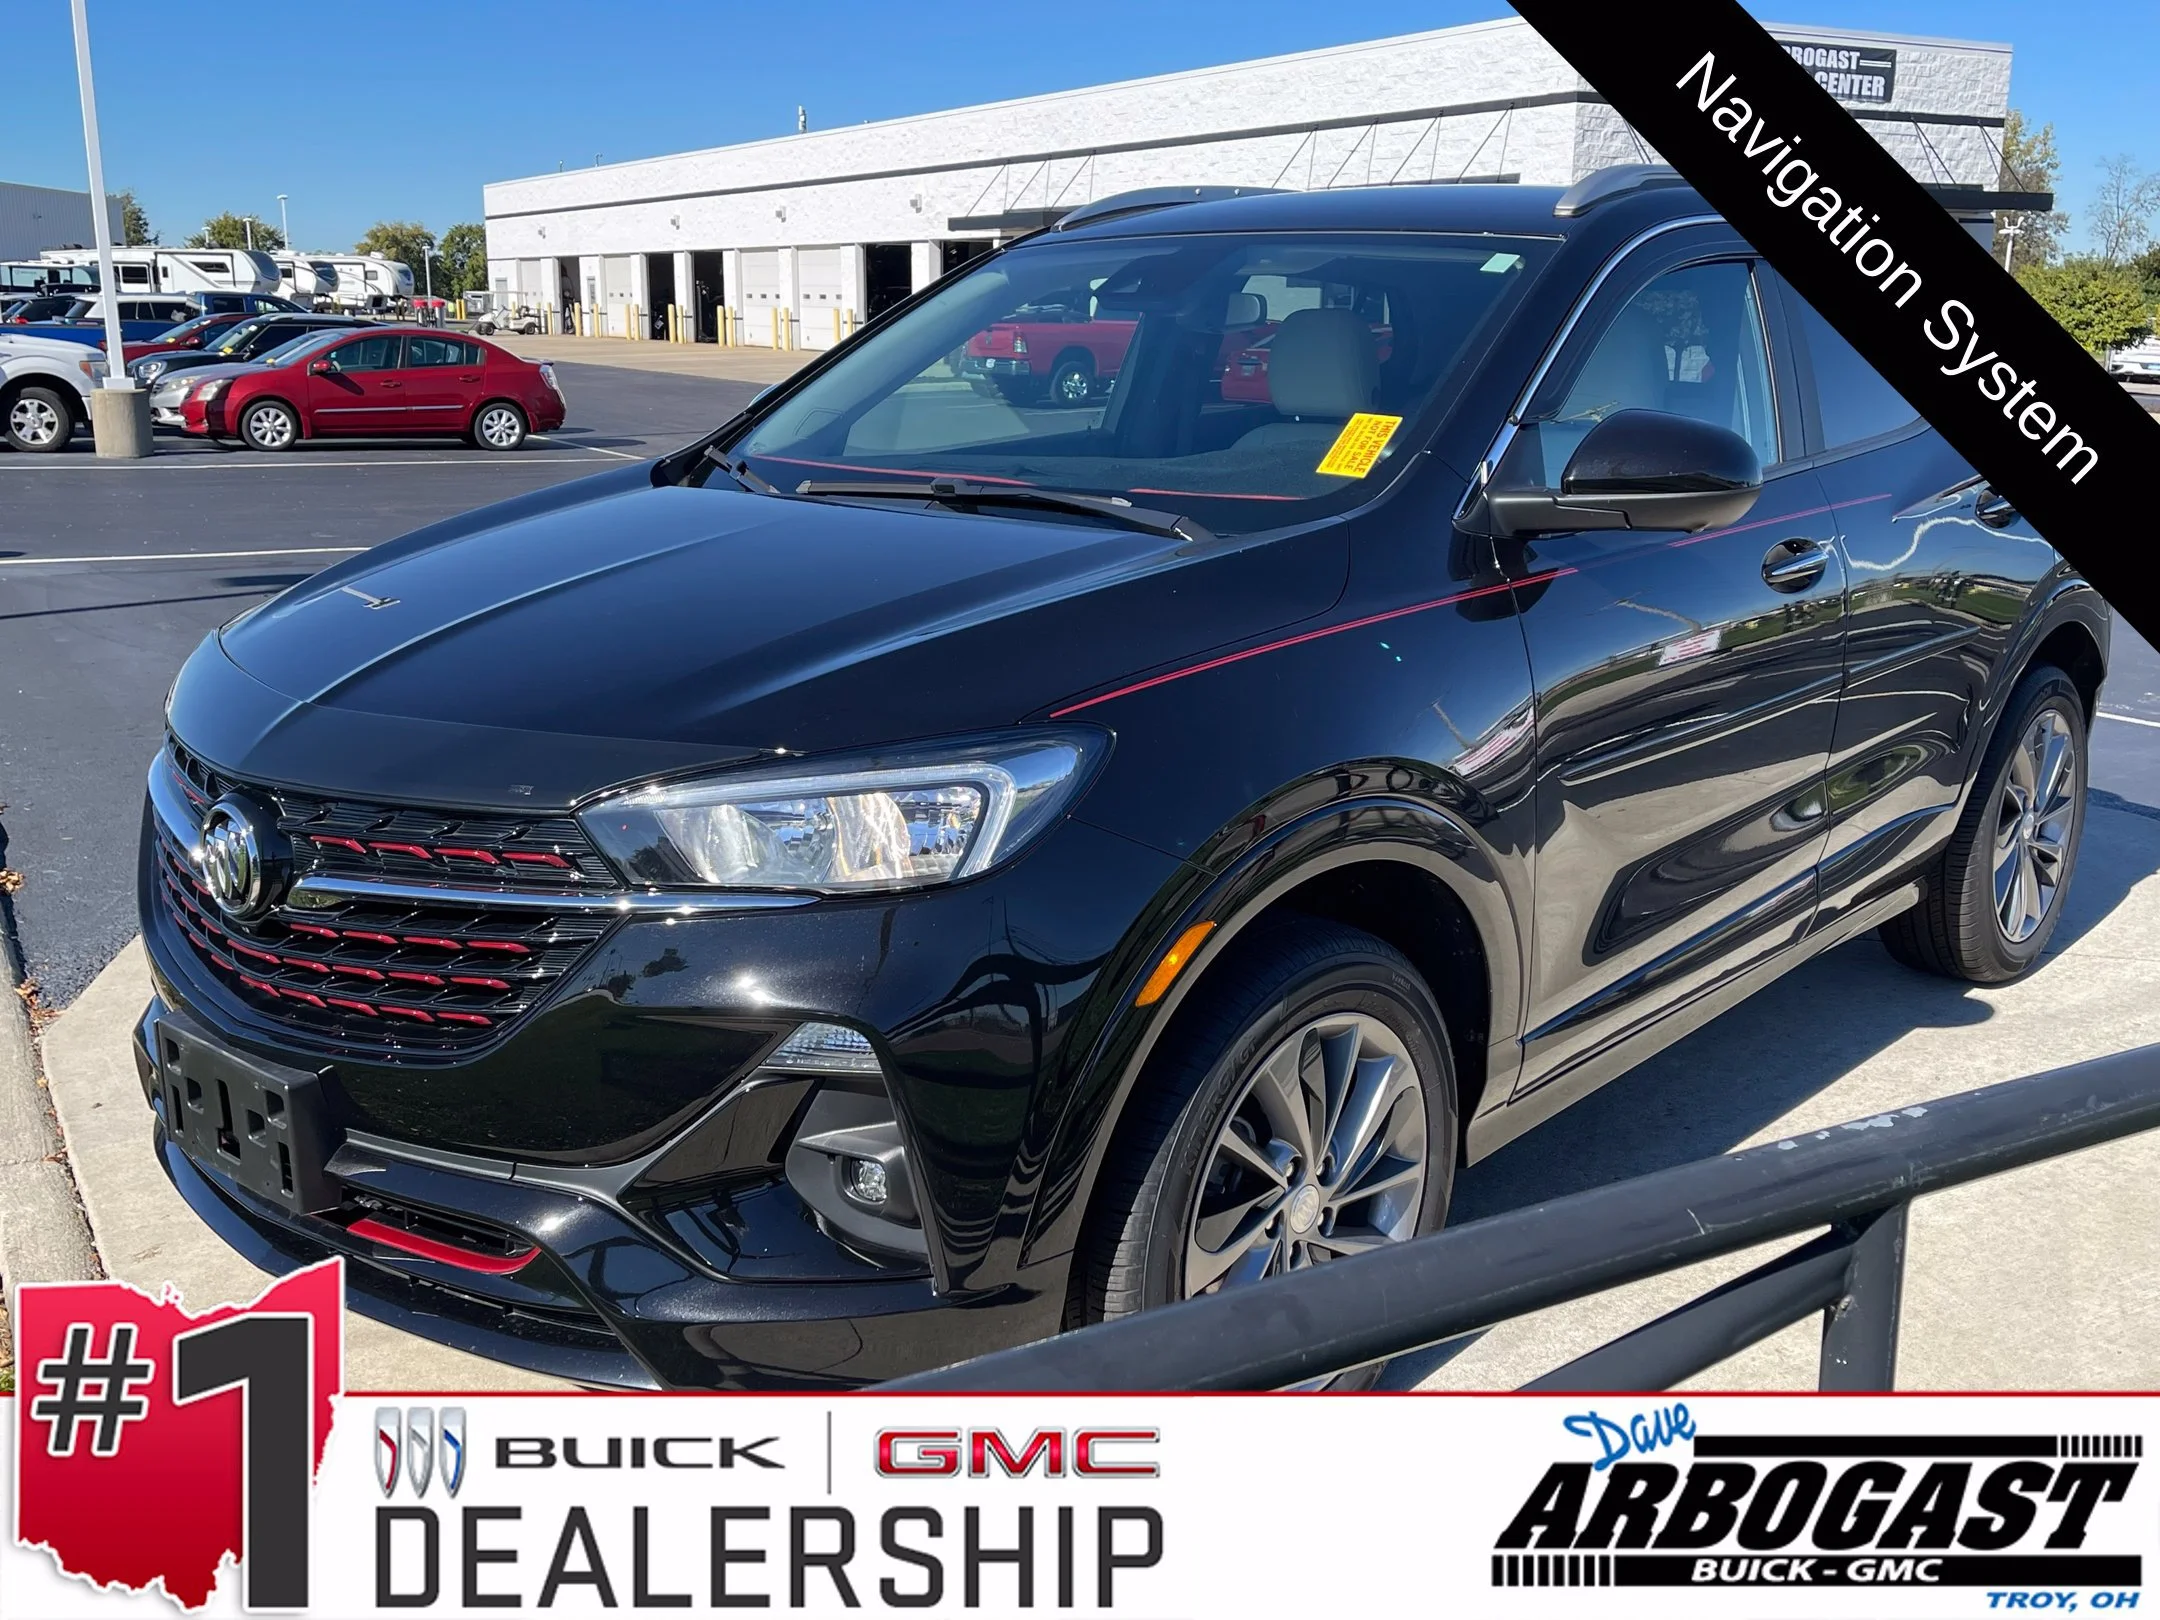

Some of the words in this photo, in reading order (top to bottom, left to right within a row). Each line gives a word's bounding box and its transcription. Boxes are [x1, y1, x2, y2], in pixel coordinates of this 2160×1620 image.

[1781, 45, 1860, 70] BOGAST
[1814, 71, 1886, 97] CENTER
[1368, 420, 1382, 434] NOT
[1376, 420, 1397, 438] THIS
[1357, 435, 1372, 450] FOR
[1344, 451, 1361, 469] SALE
[1353, 440, 1384, 473] VEHICLE
